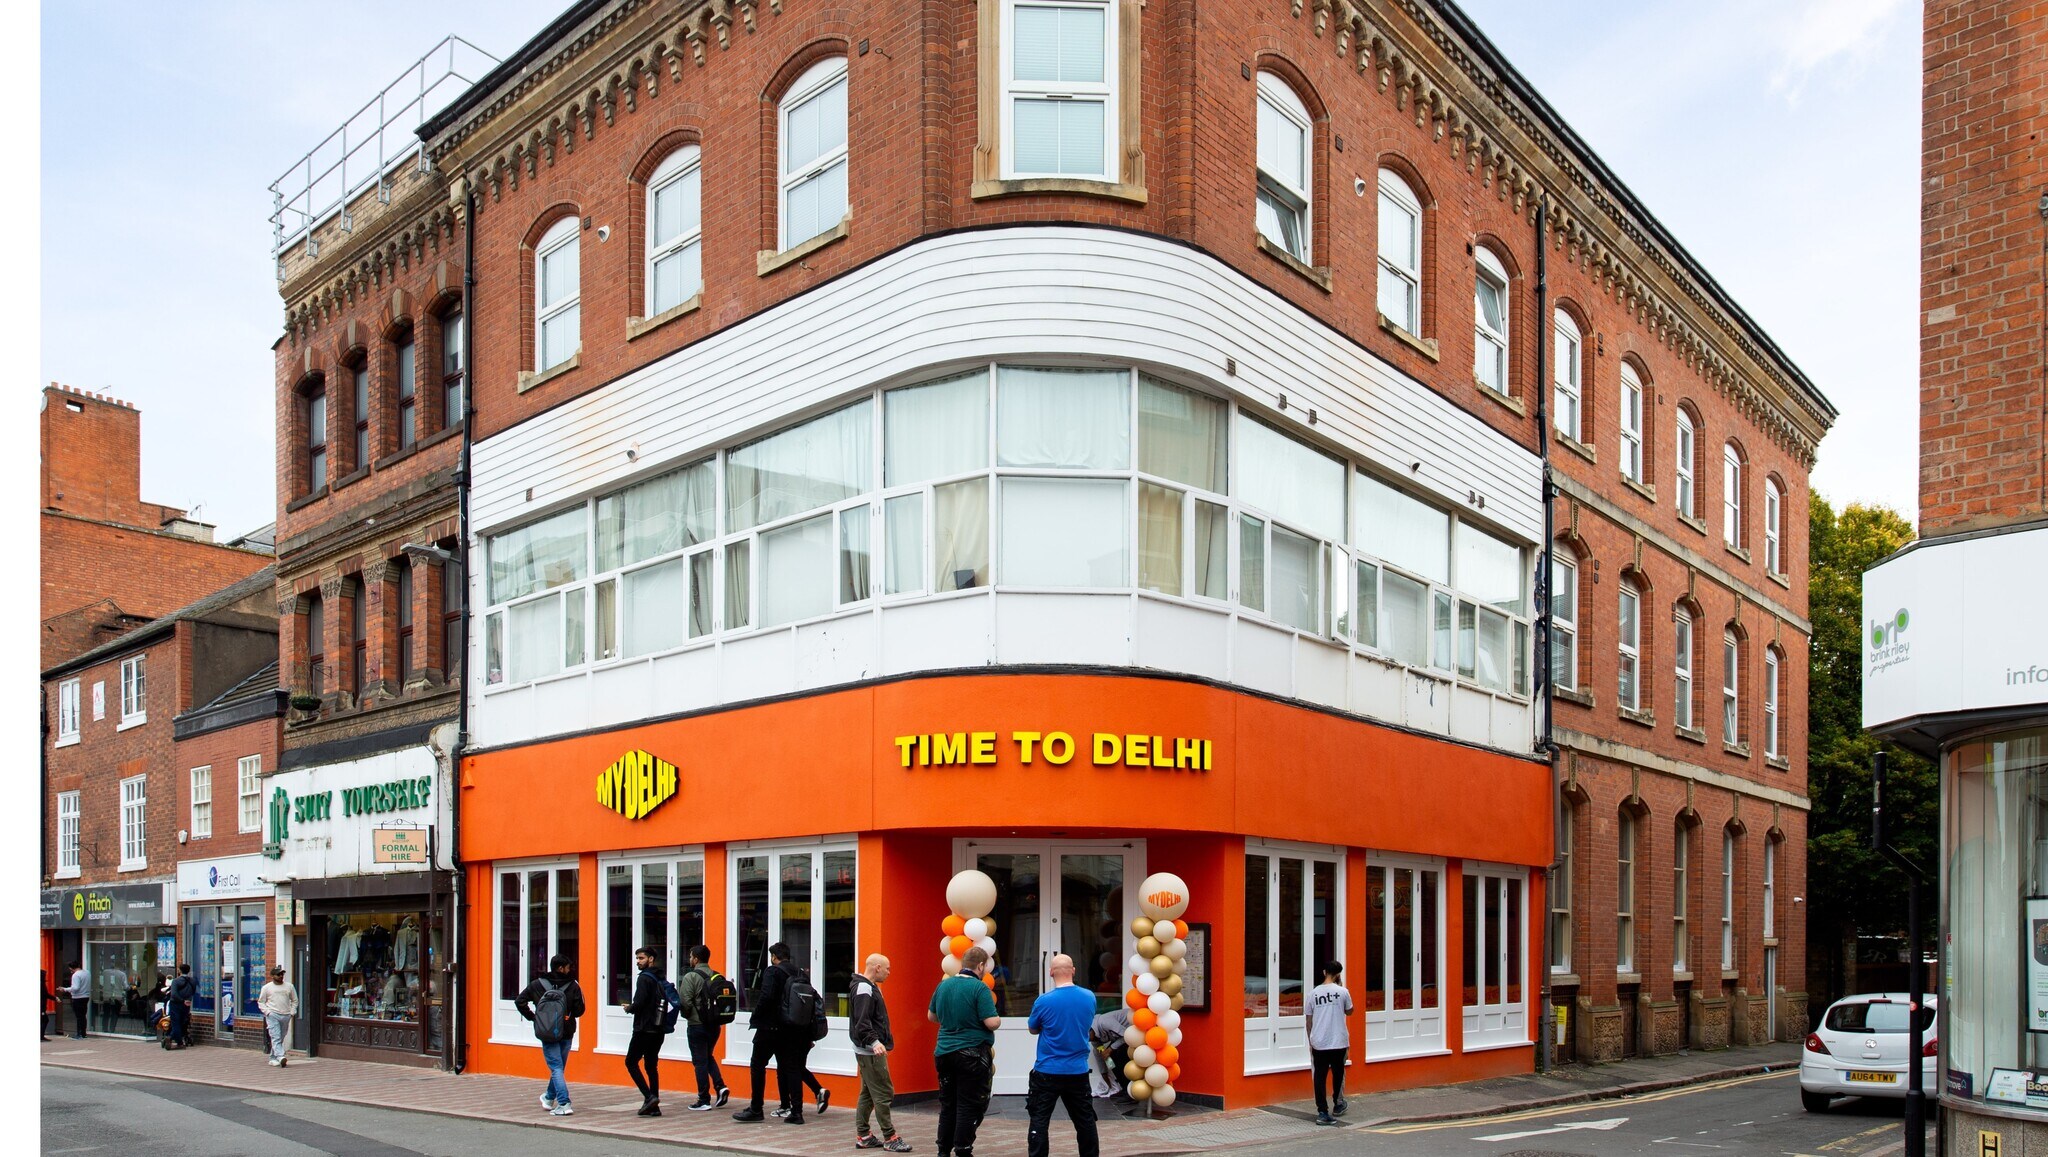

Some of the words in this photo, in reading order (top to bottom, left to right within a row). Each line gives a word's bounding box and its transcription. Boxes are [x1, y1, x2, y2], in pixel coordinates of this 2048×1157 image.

[1871, 646, 1890, 663] brink
[1891, 642, 1910, 656] riley
[895, 732, 997, 767] TIME
[1012, 731, 1075, 765] TO
[1092, 733, 1212, 771] DELHI
[596, 748, 677, 820] MYDELHI
[294, 790, 332, 823] SUIT
[340, 775, 431, 817] YOURSELF
[381, 844, 420, 852] FORMAL
[390, 853, 412, 861] HIRE
[1148, 890, 1182, 909] MYDELHI
[1851, 1072, 1874, 1081] AU64
